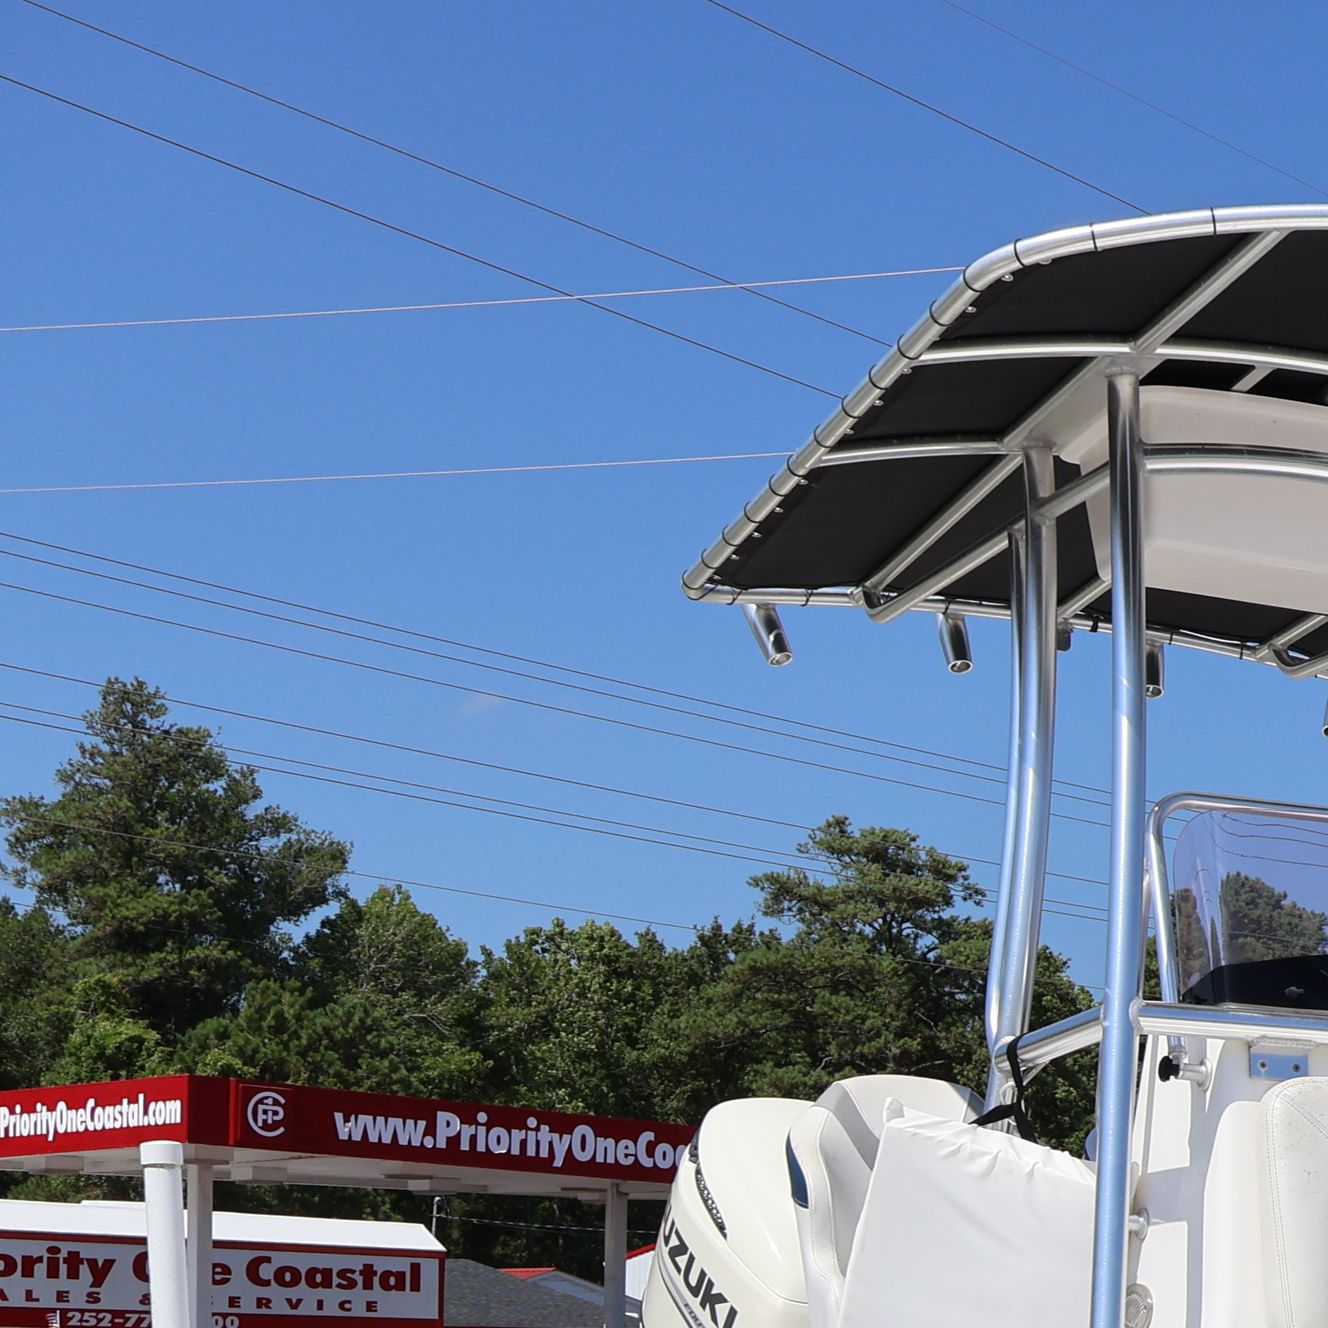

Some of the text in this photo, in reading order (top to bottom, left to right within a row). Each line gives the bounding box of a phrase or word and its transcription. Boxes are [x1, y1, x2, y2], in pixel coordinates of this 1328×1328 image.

[0, 1093, 181, 1141] PriorityOneCoastal.com
[245, 1255, 421, 1293] Coastal
[211, 1296, 379, 1313] ERVICE
